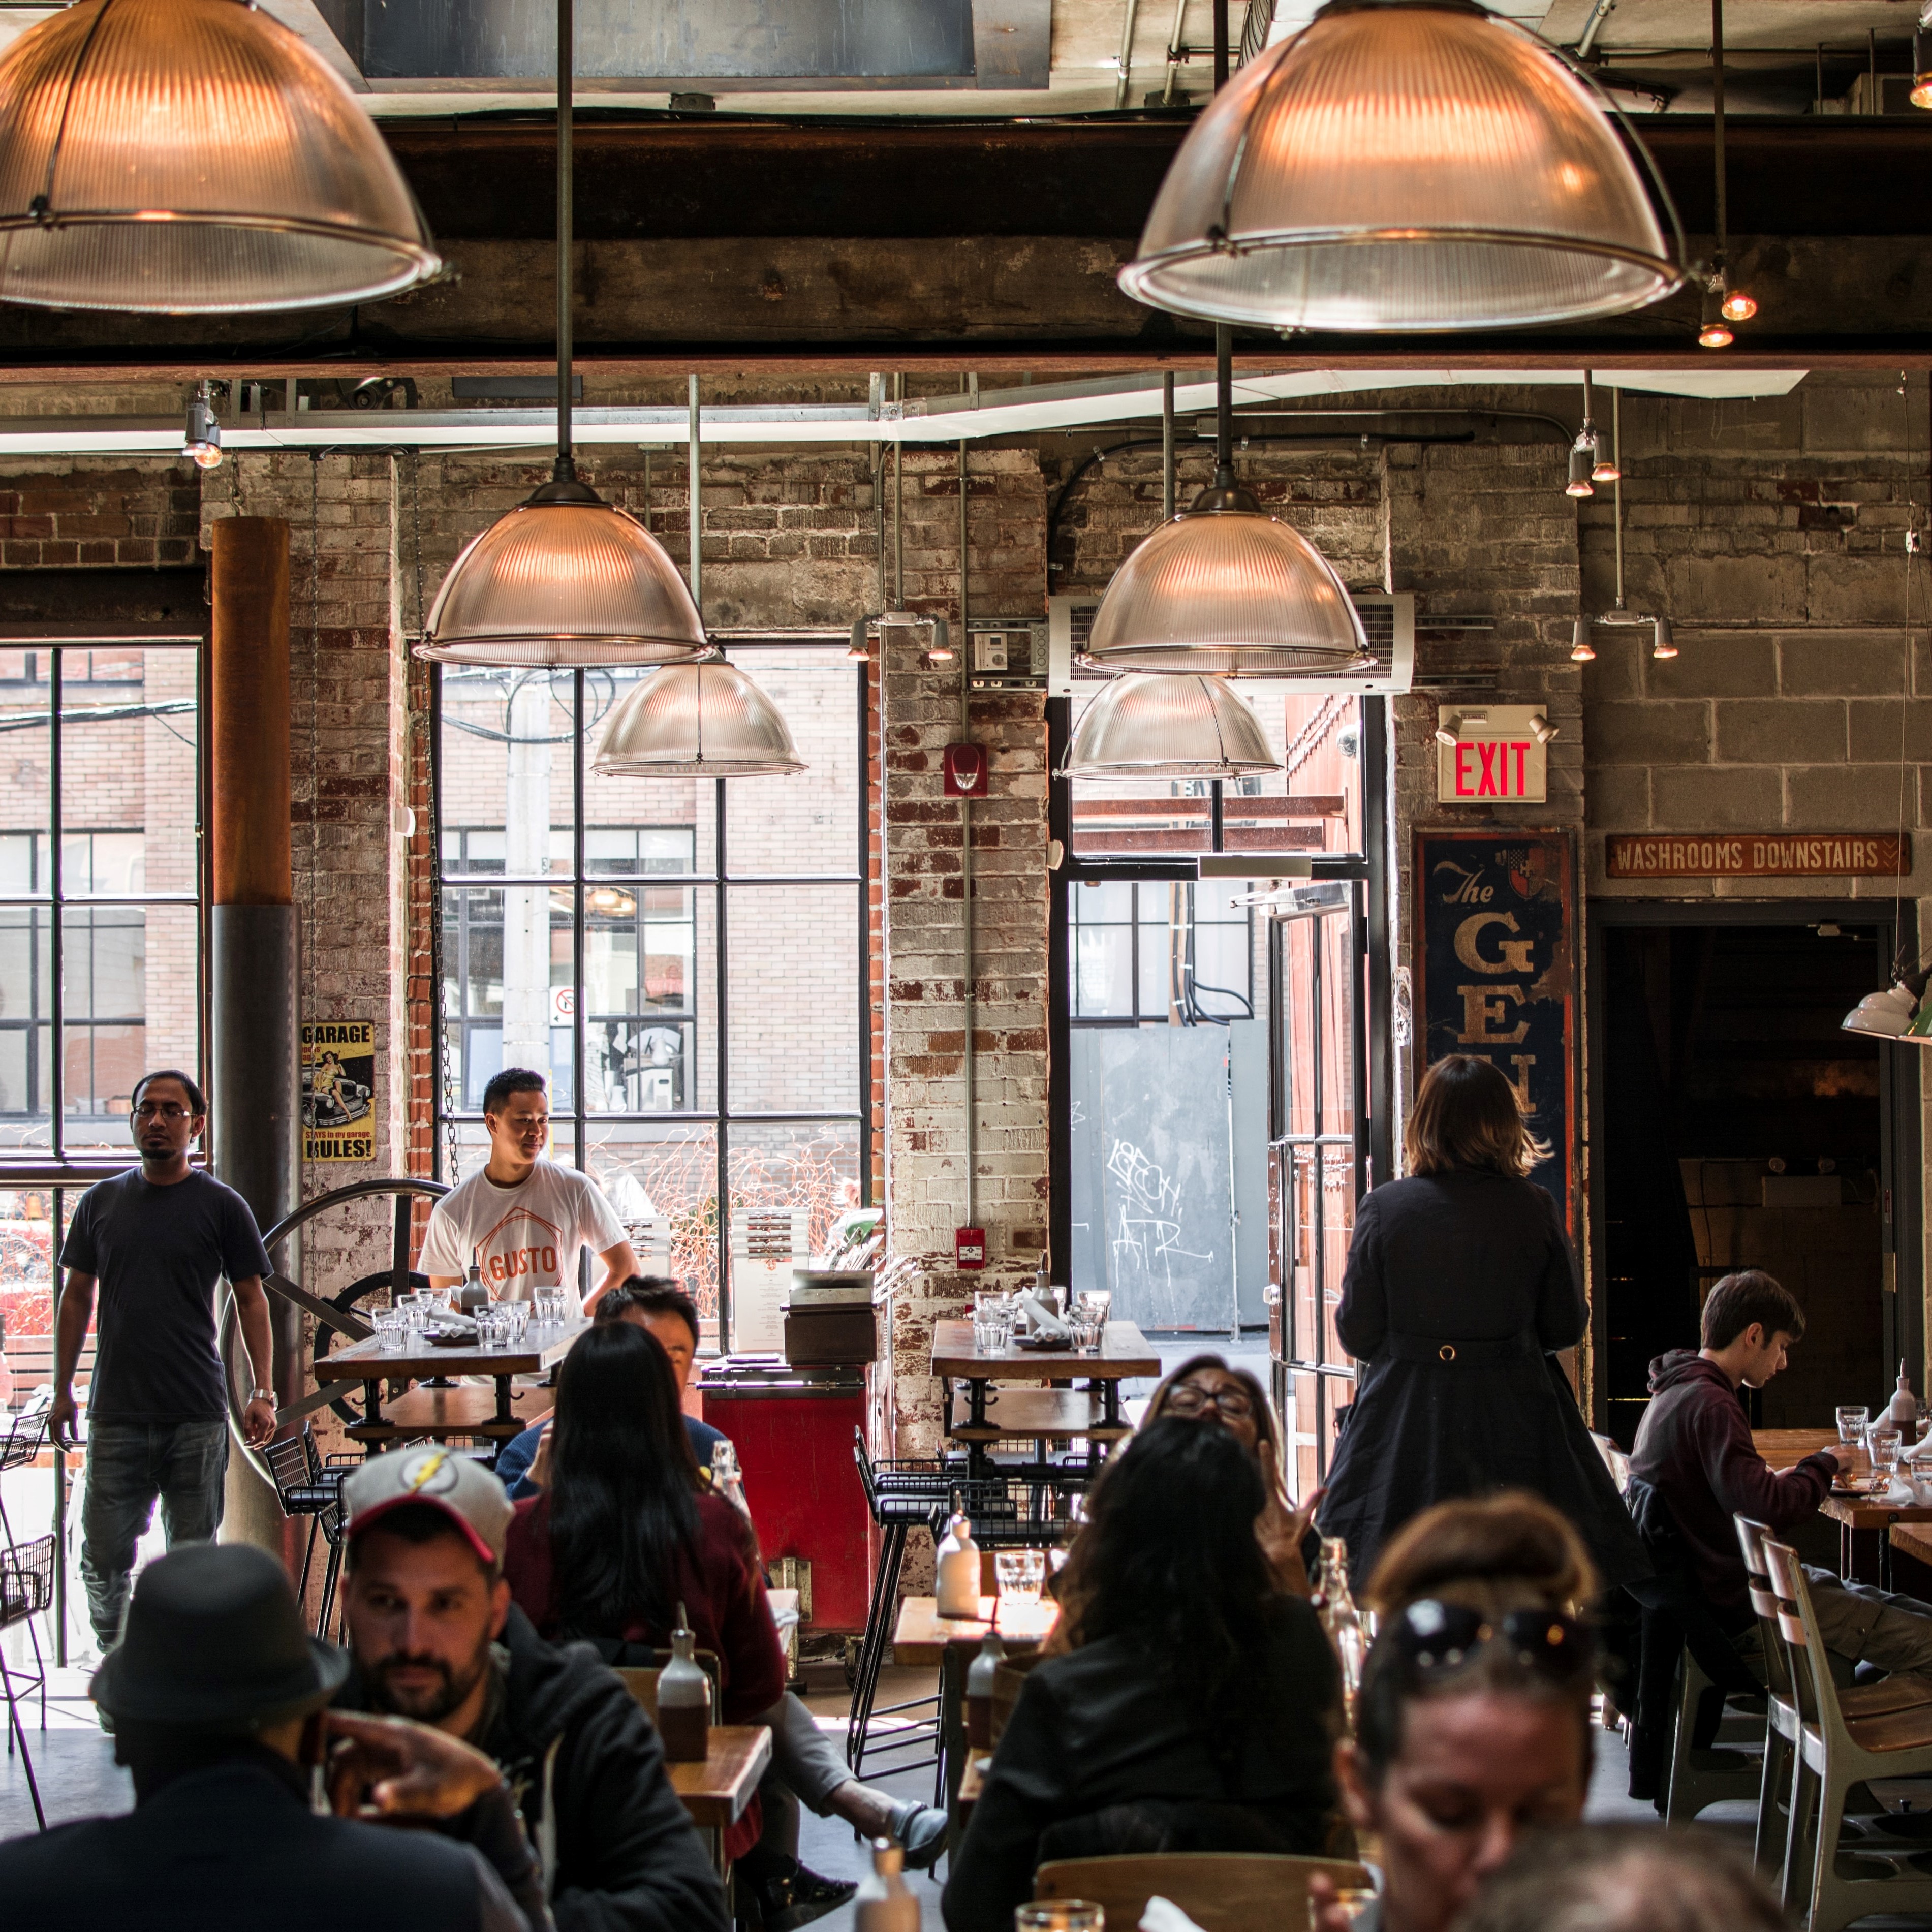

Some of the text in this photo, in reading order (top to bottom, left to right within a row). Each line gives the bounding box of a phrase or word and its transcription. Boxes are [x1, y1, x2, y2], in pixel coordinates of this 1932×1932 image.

[1455, 742, 1531, 796] EXIT
[1616, 840, 1879, 870] WASHROOMS DOWNSTAIRS
[1433, 861, 1494, 903] The
[303, 1025, 370, 1044] GARAGE
[307, 1139, 371, 1158] RULES!
[489, 1246, 557, 1281] GUSTO
